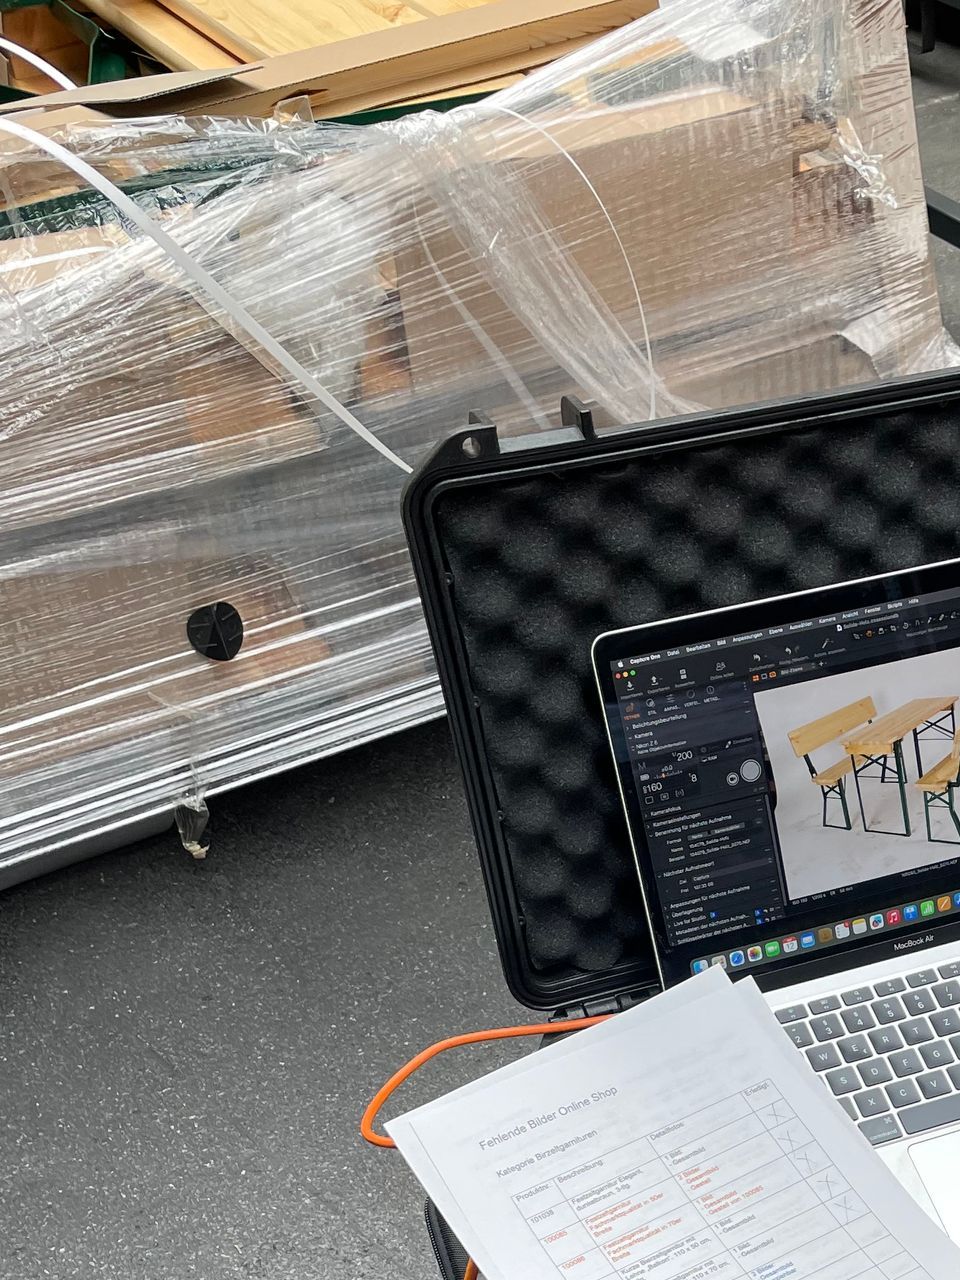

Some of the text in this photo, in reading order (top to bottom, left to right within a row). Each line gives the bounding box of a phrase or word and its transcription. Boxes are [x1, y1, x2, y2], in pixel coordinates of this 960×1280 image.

[894, 938, 925, 951] MacBook
[478, 1087, 617, 1150] Fehlende Bilder Online Shop
[495, 1157, 535, 1177] Kategorie
